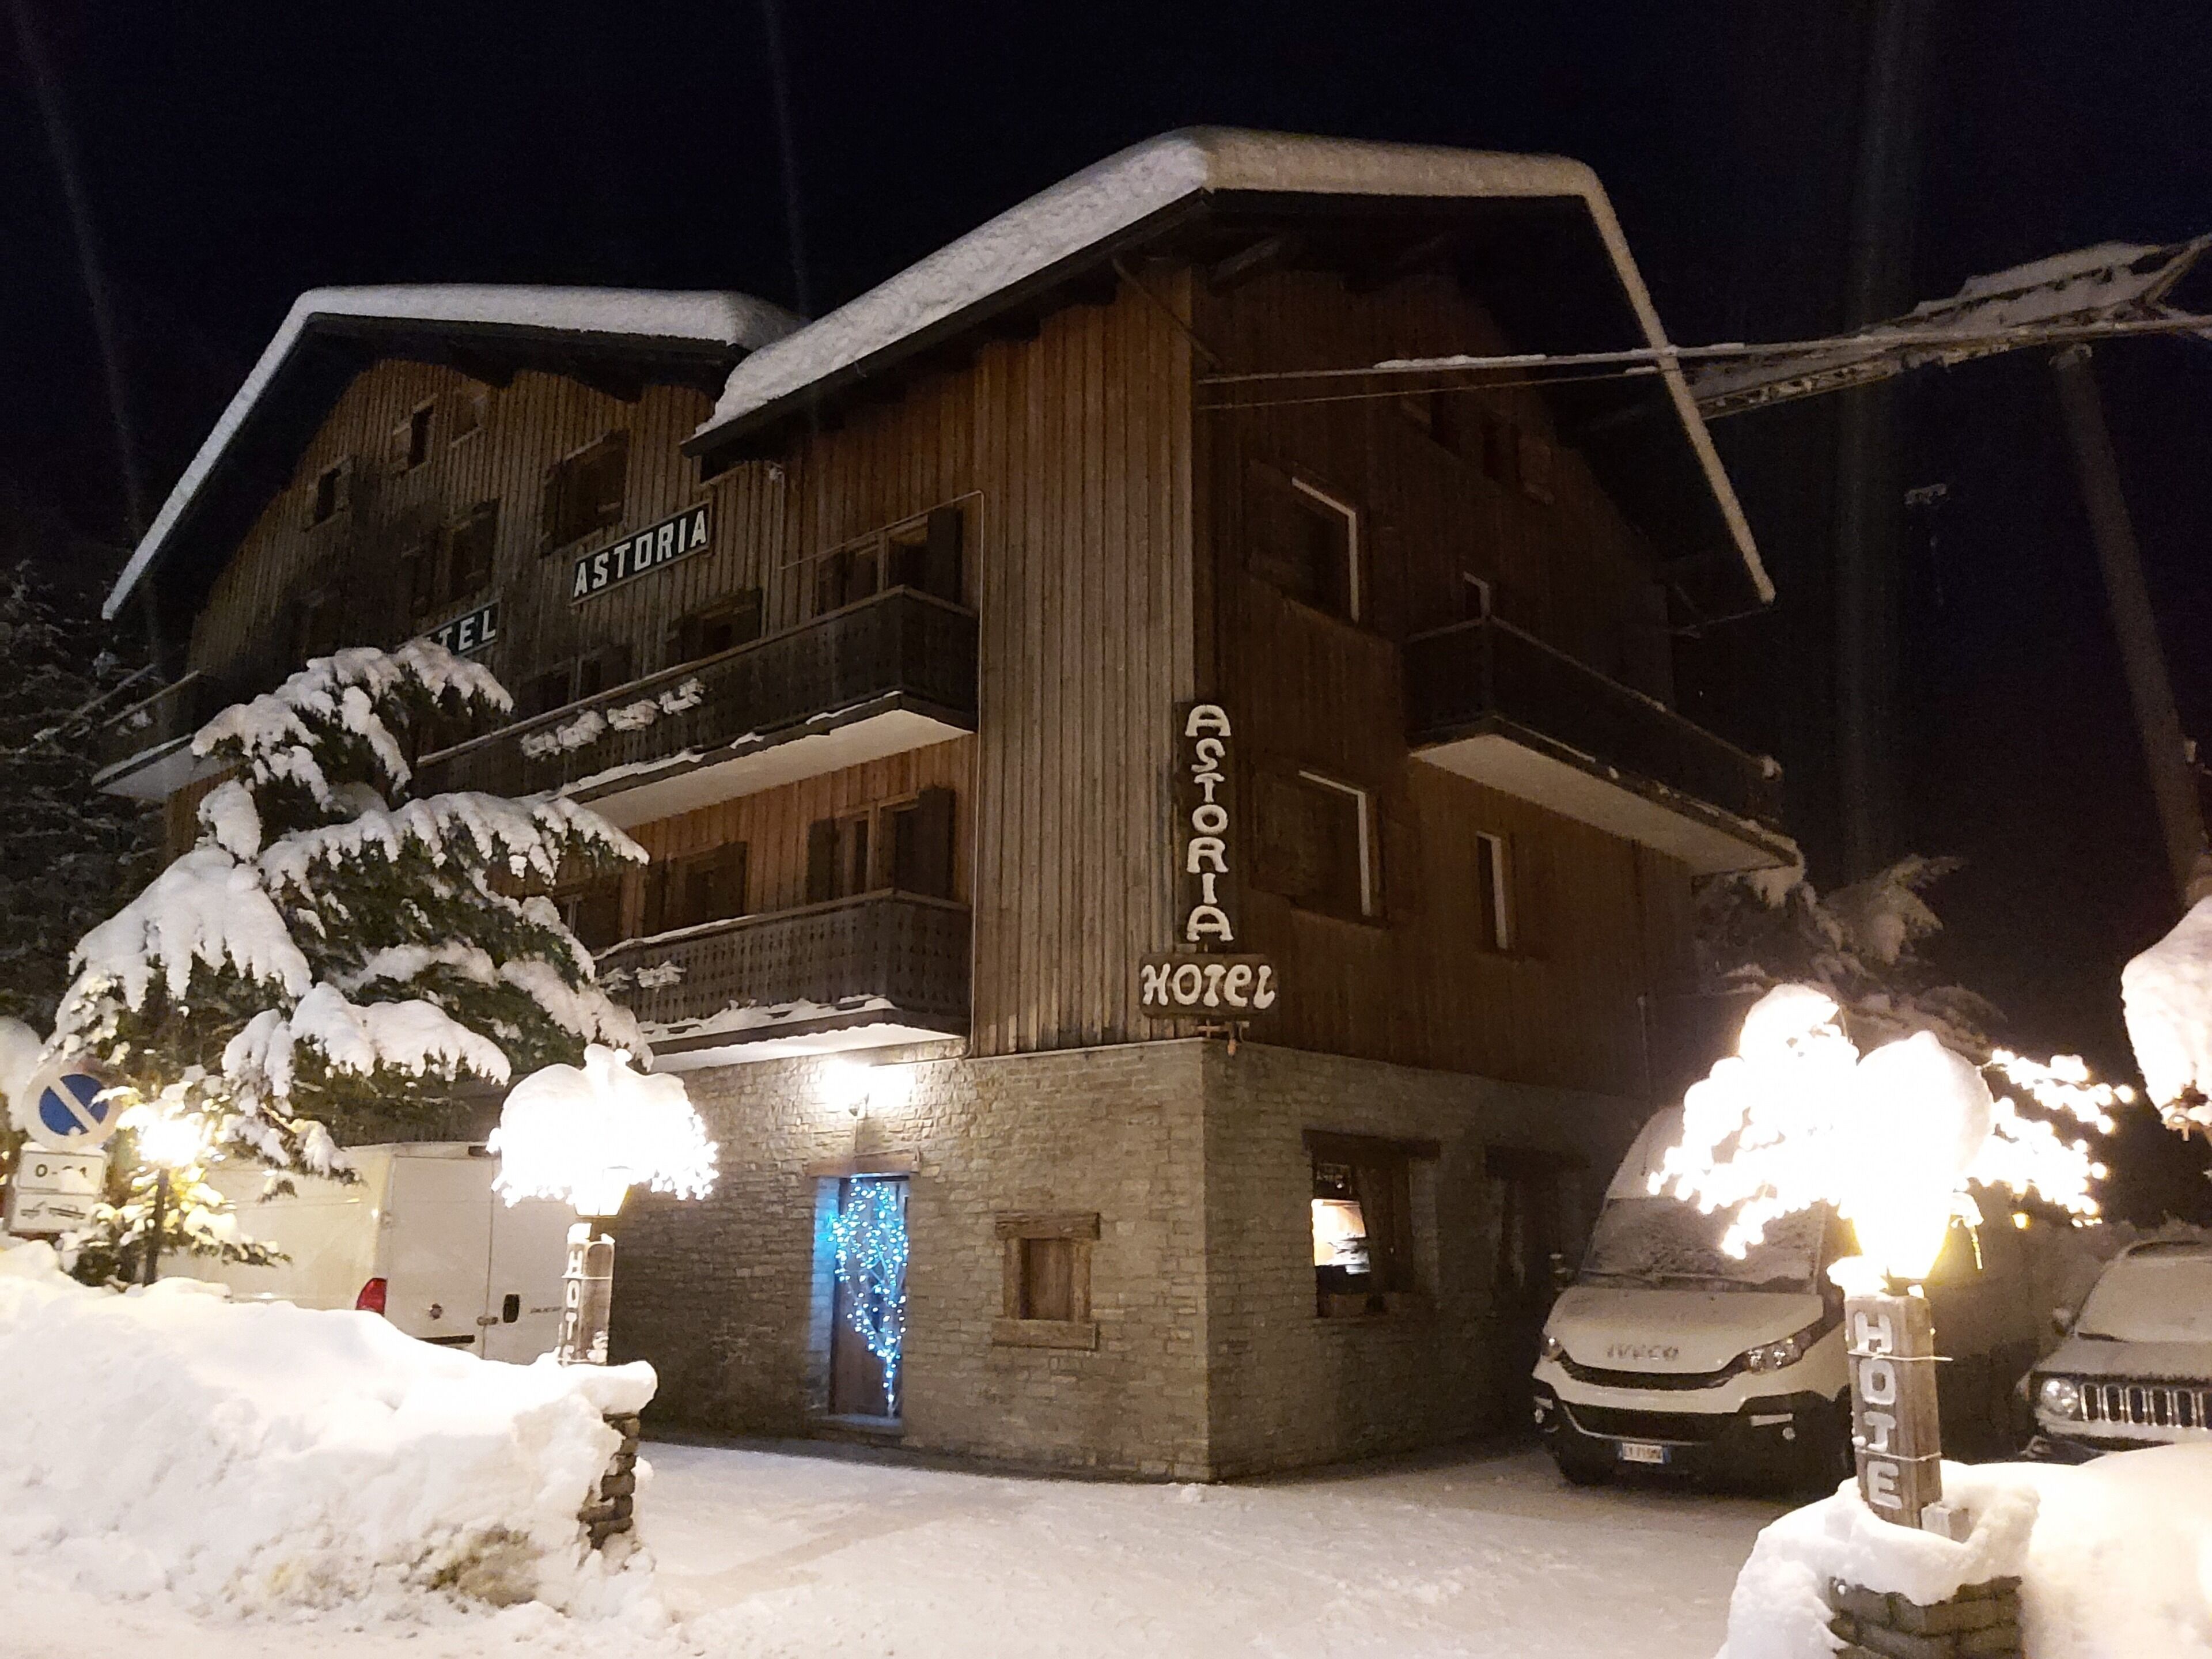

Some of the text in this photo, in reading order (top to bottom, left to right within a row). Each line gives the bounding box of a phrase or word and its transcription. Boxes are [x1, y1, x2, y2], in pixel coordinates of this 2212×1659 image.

[574, 509, 707, 597] ASTORIA
[425, 609, 496, 652] TEL
[1184, 704, 1234, 941] ASTORIA
